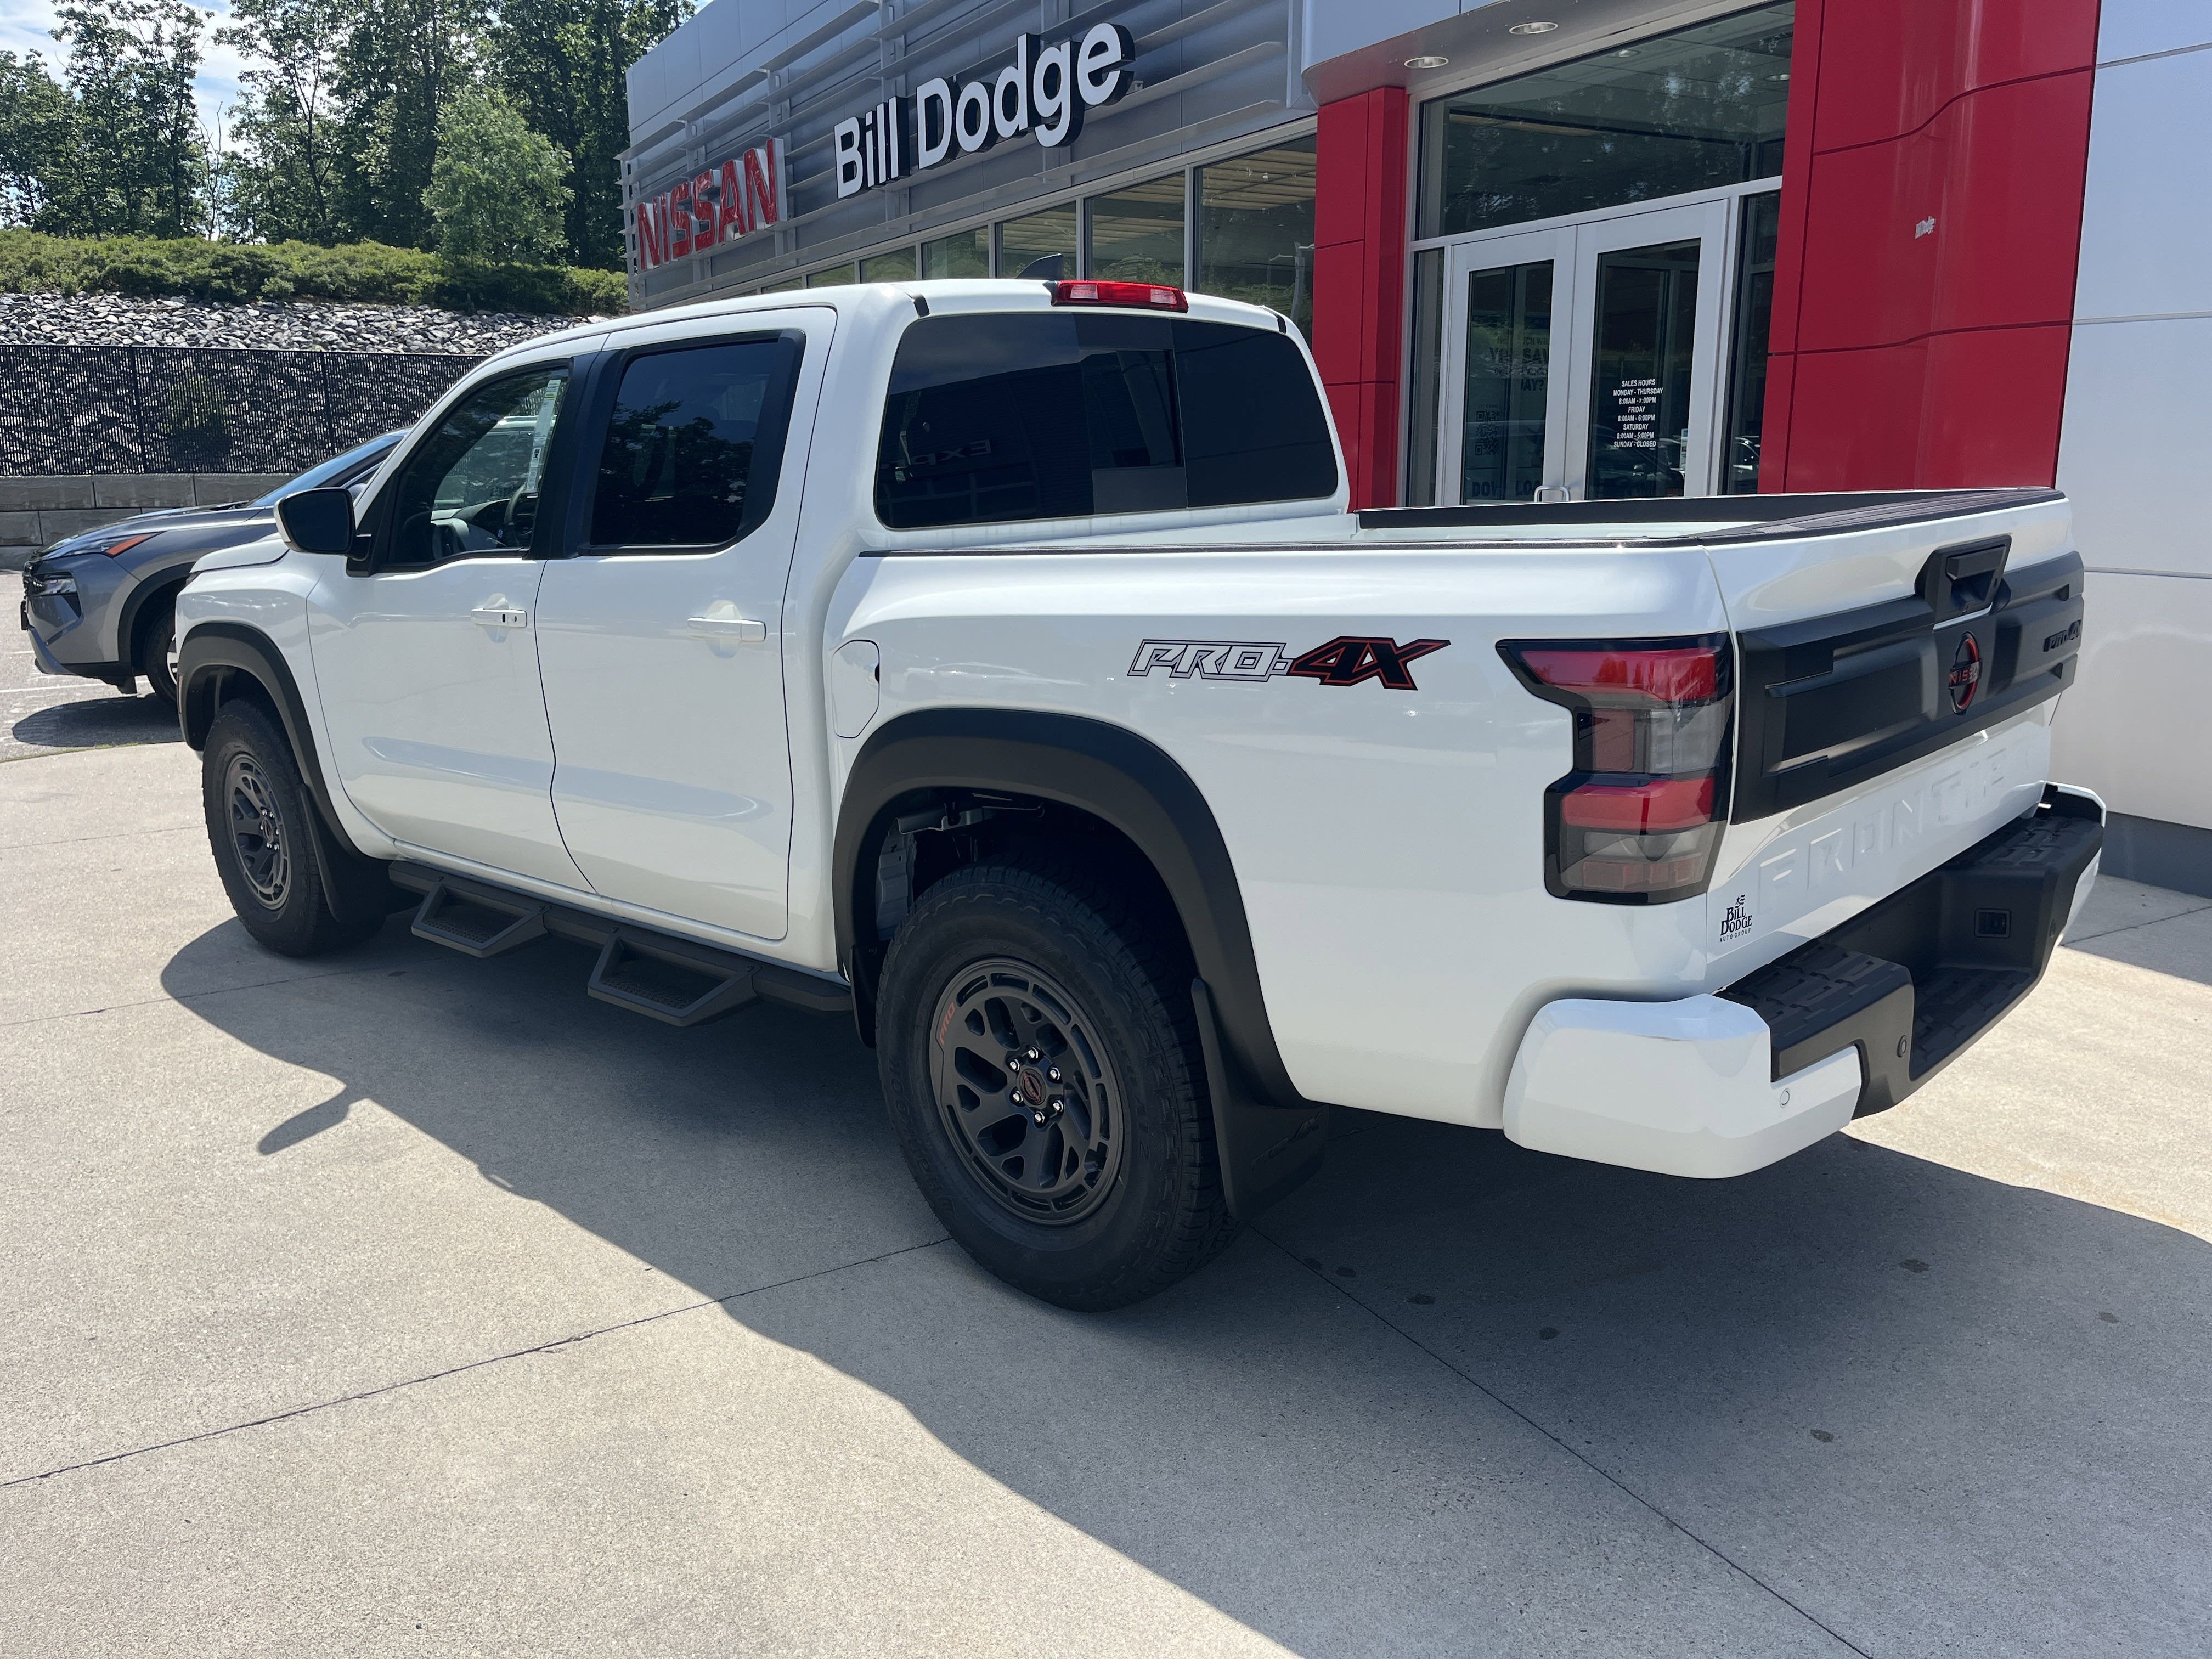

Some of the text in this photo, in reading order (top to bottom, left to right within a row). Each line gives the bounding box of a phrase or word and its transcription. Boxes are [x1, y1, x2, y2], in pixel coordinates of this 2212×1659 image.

[834, 22, 1125, 199] Bill Dodge
[638, 138, 780, 270] NISSAN
[1758, 742, 2028, 915] FRONTIE
[1719, 928, 1751, 943] AUTO GROUP
[1720, 915, 1752, 936] DODGE
[1726, 906, 1747, 922] BILL
